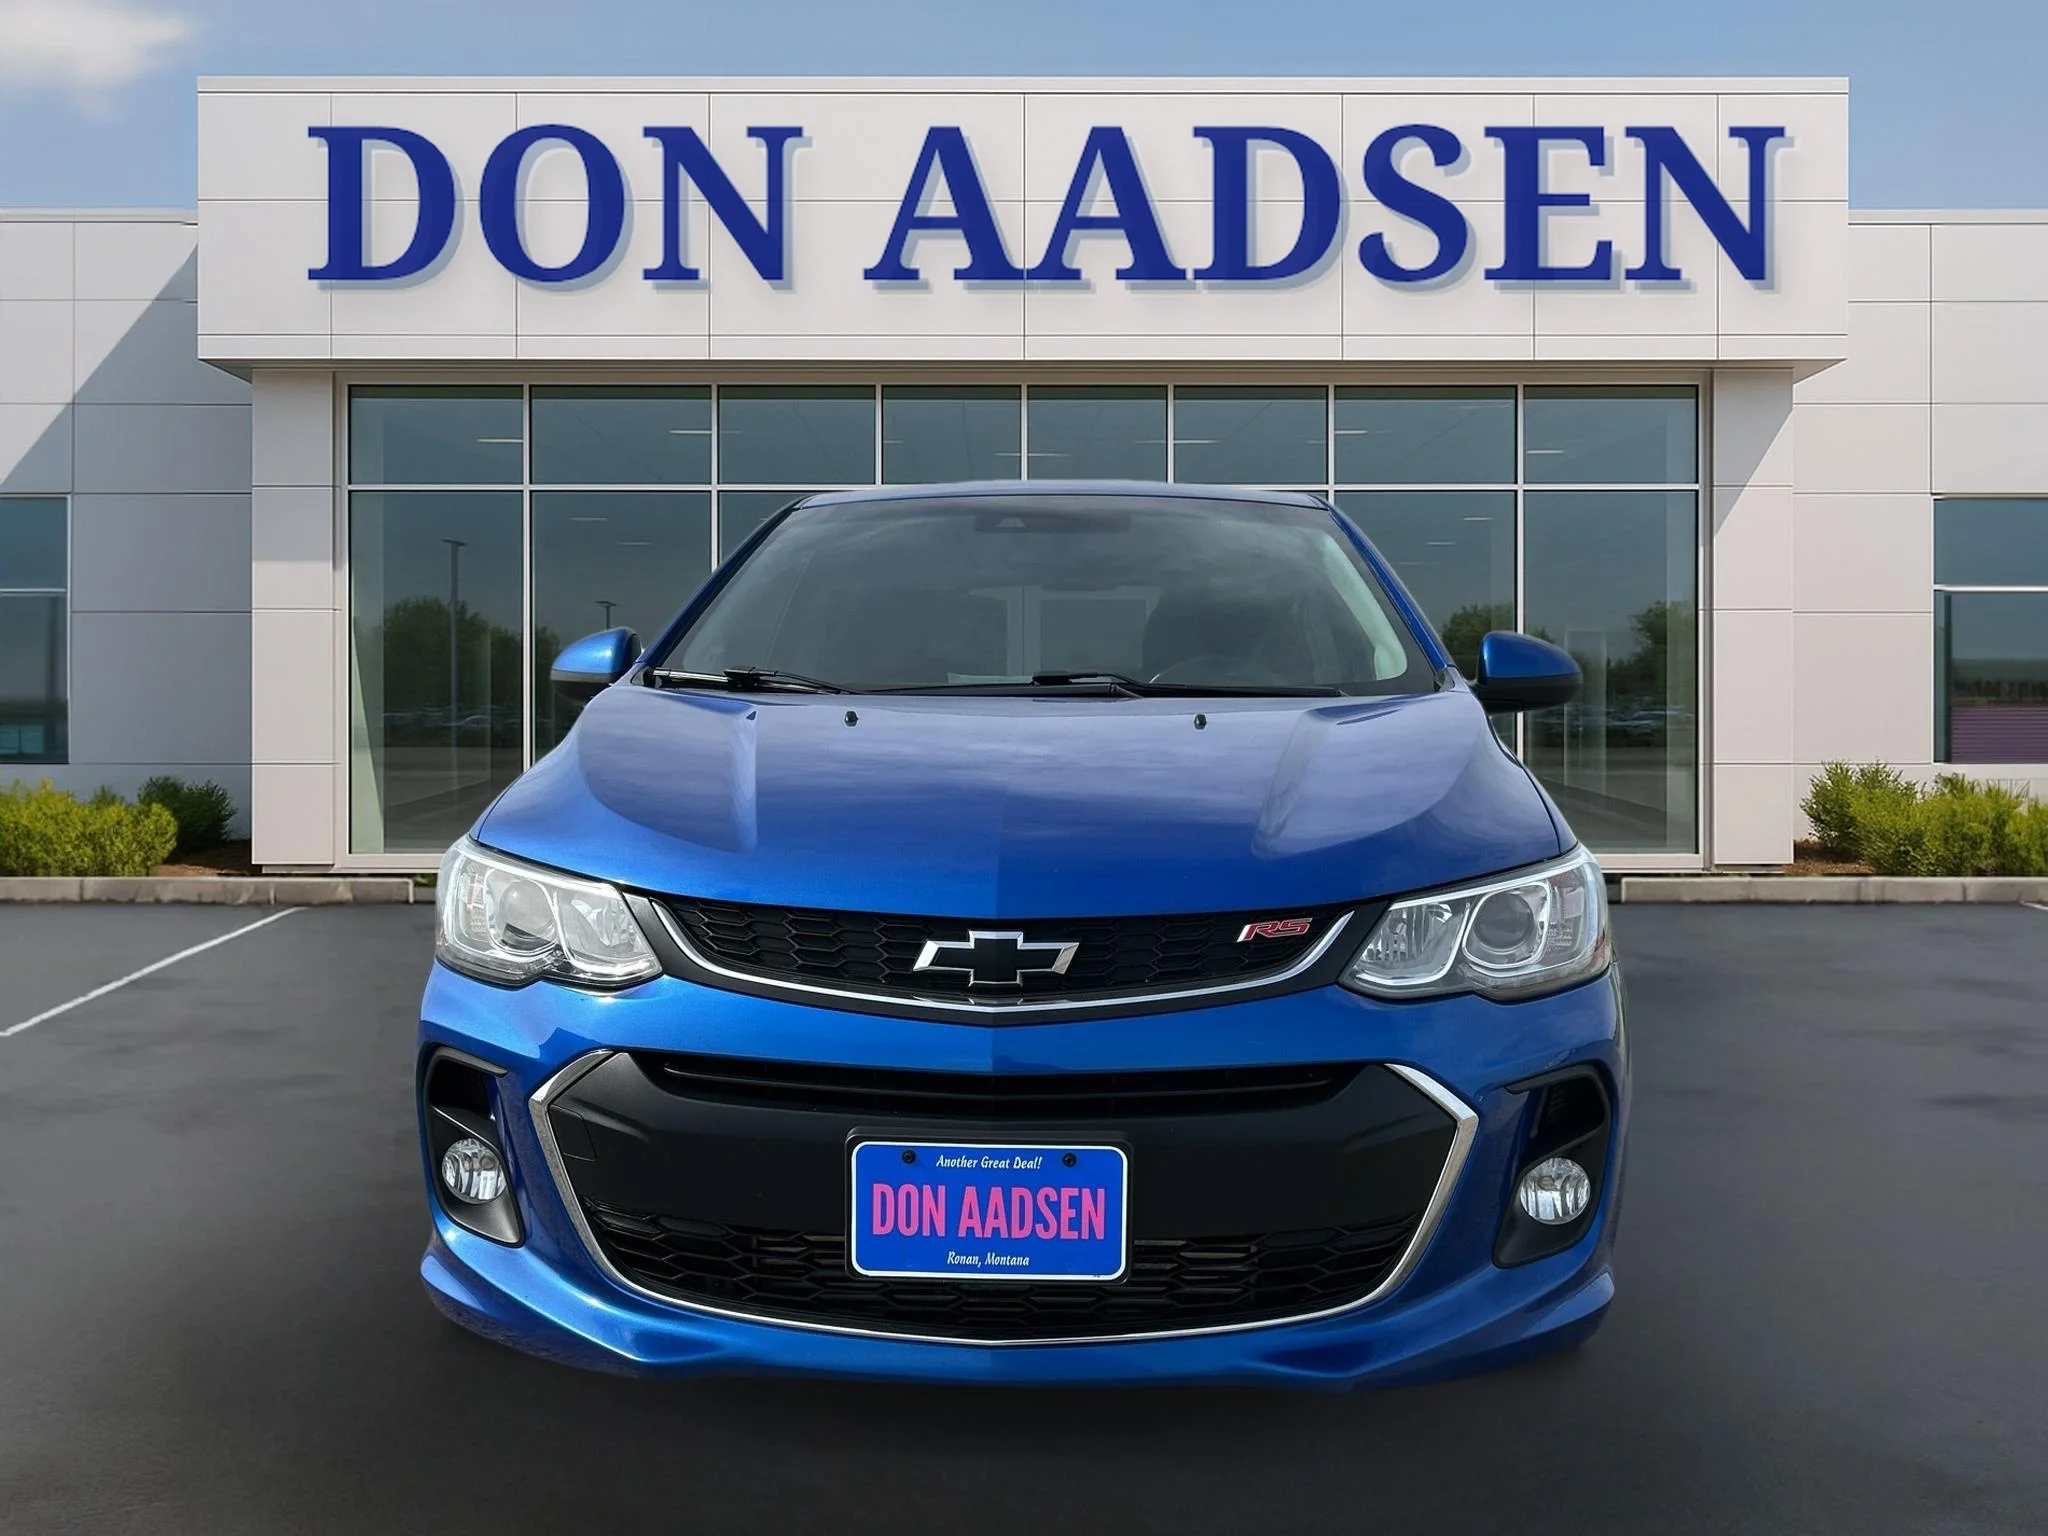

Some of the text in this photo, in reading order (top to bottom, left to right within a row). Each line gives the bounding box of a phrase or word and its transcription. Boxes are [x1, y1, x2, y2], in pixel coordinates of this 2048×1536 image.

[308, 124, 1785, 283] DON AADSEN
[1237, 918, 1313, 942] RS
[936, 1154, 1043, 1170] Another Great Deal!
[872, 1183, 1106, 1240] DON AADSEN
[946, 1251, 1030, 1267] Ronan, Montana
